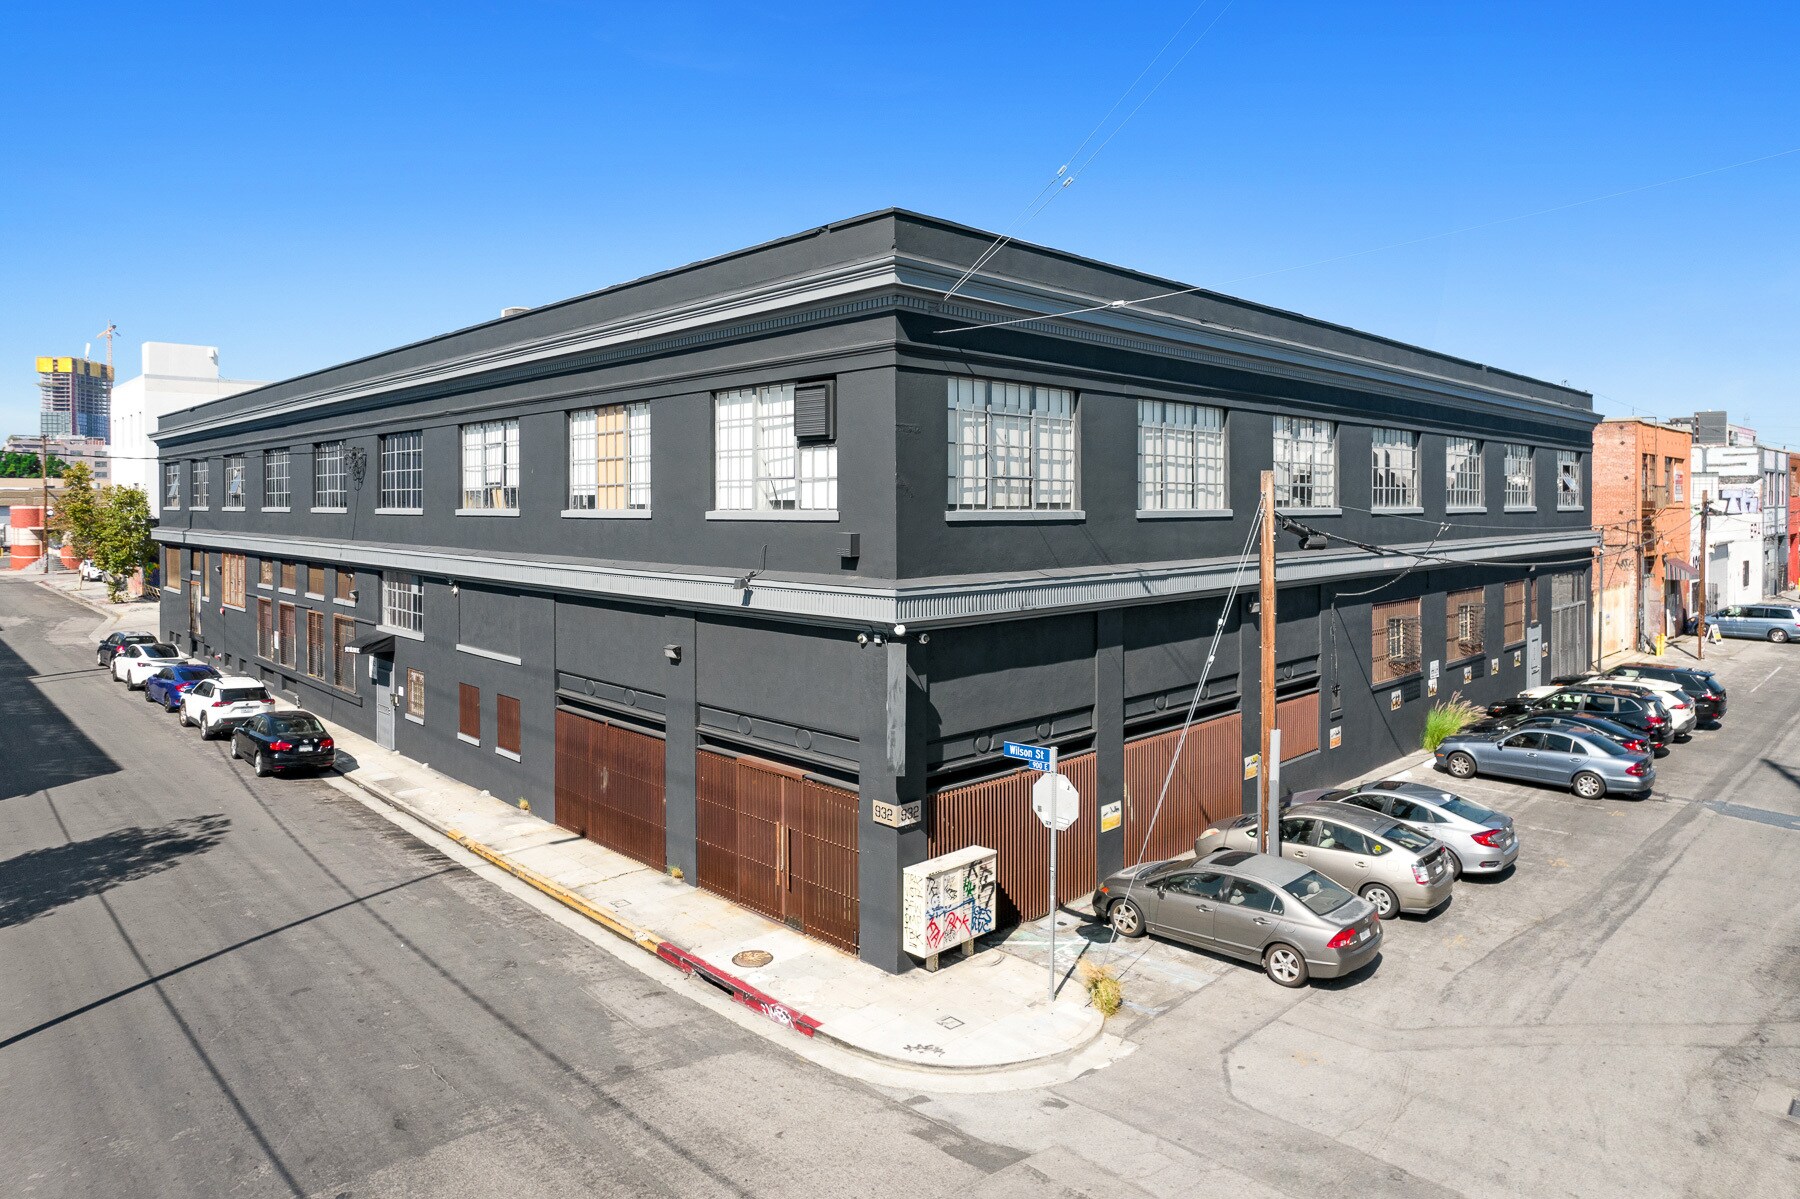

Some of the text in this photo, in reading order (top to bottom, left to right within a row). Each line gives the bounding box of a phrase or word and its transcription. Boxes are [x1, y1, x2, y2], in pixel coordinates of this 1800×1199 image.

[1010, 745, 1044, 760] Wilson St
[874, 804, 893, 822] 932
[900, 805, 920, 822] 932
